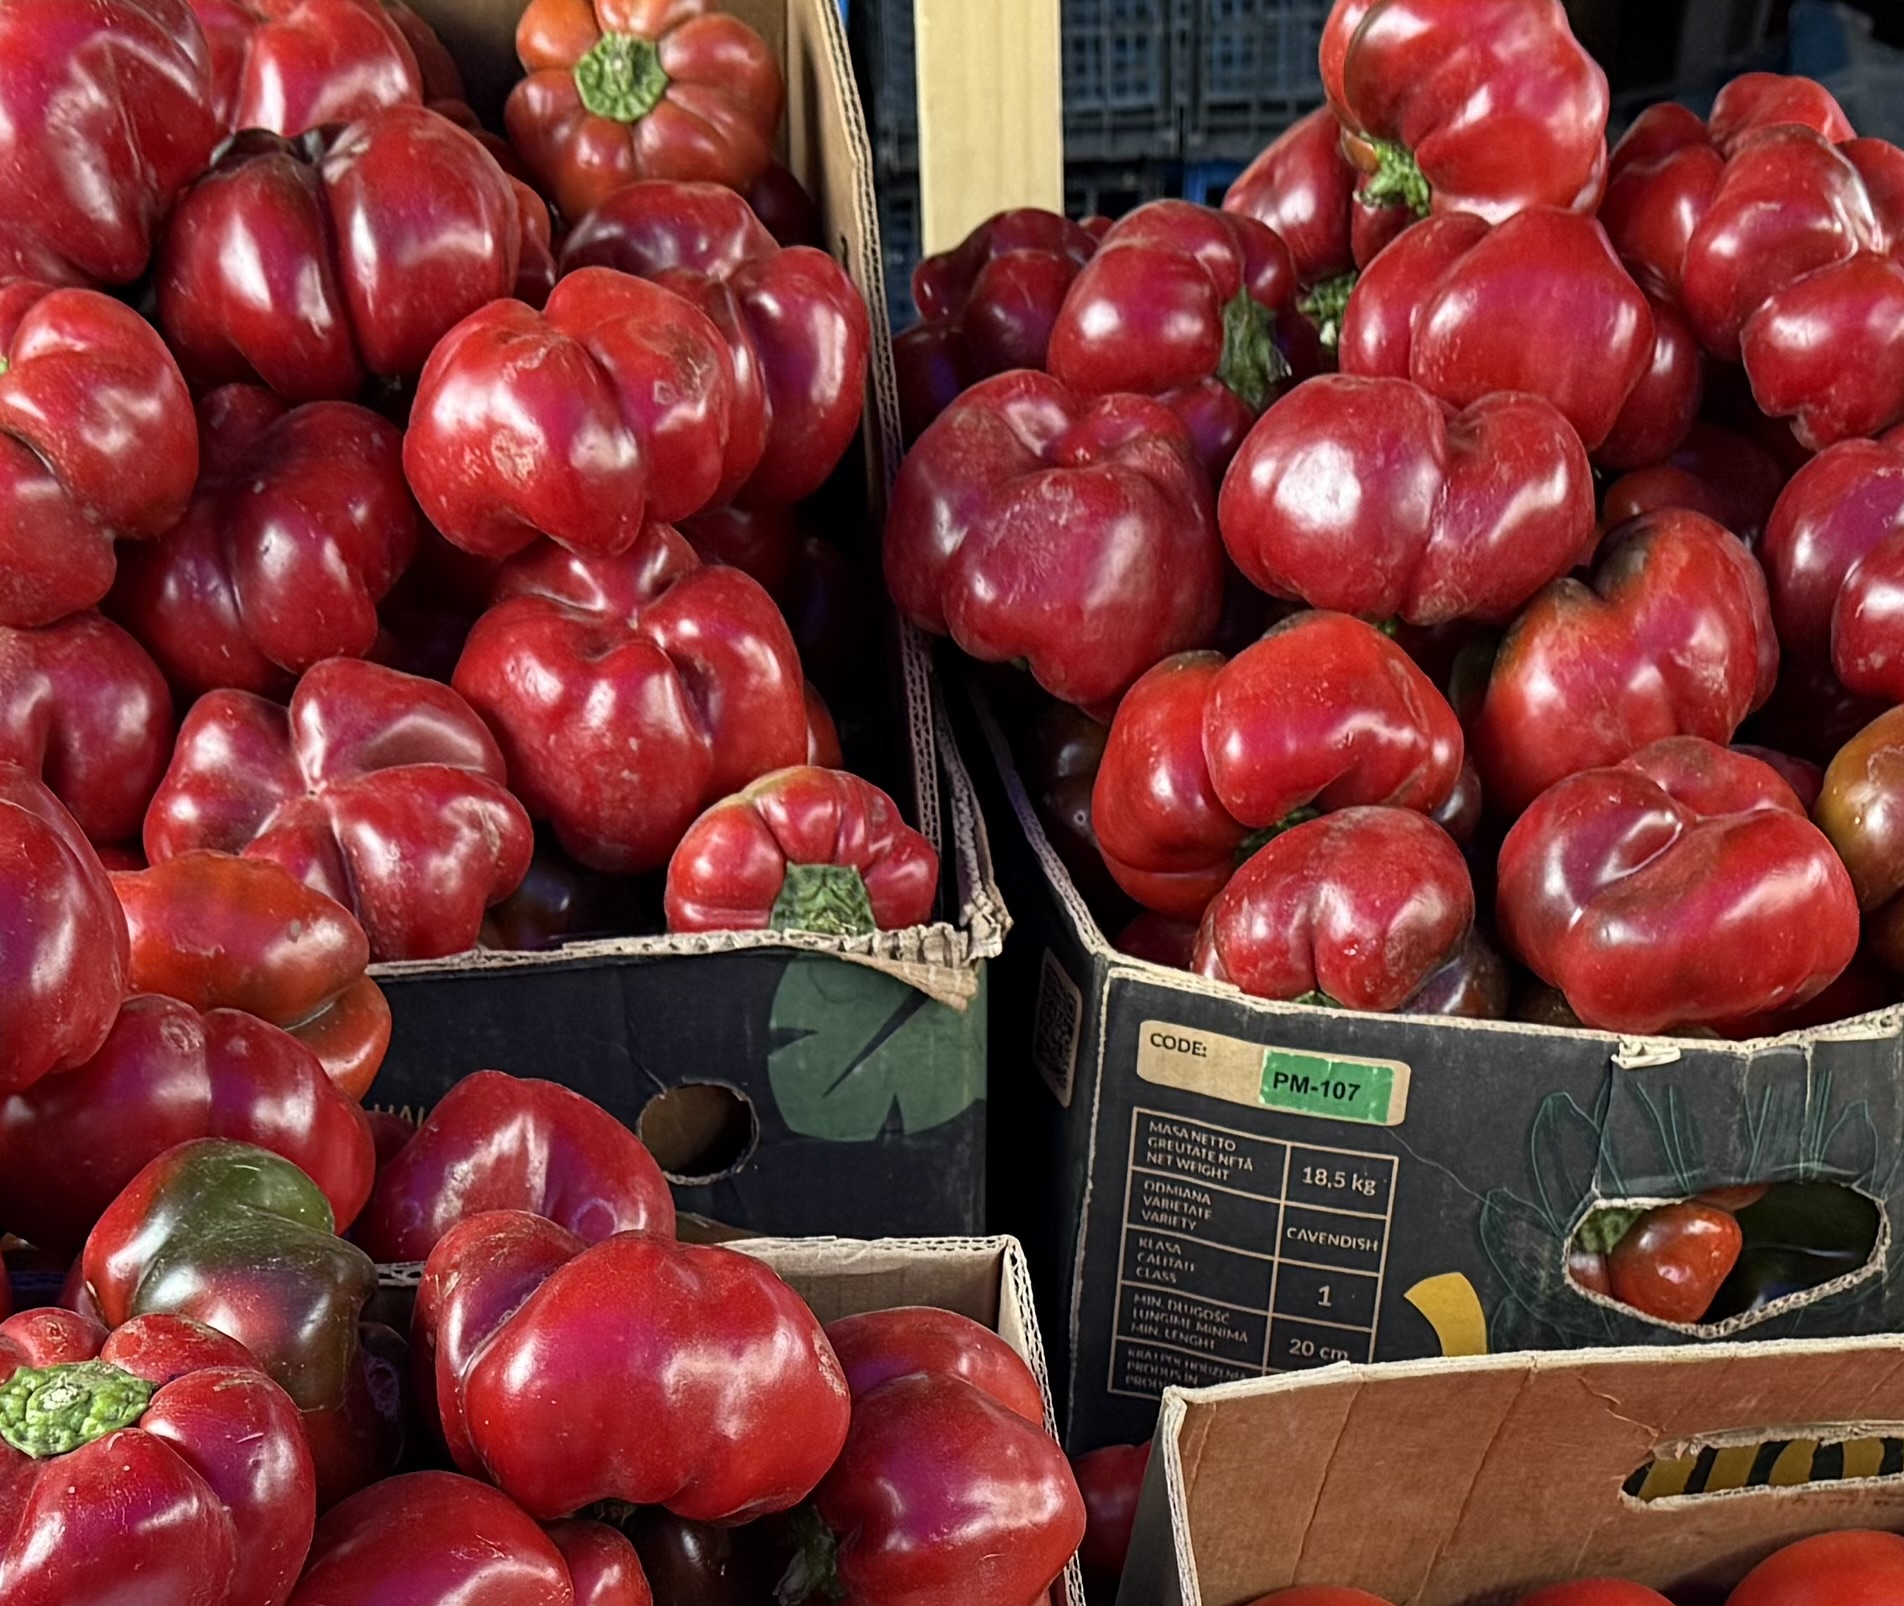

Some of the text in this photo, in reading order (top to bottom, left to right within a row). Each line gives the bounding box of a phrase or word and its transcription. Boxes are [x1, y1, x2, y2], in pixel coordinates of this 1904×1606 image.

[1150, 1031, 1361, 1102] CODE: PM-107
[1149, 1121, 1236, 1151] MASA NETTO
[1351, 1173, 1377, 1197] kg
[1286, 1227, 1378, 1252] CAVENDISH
[1317, 1285, 1332, 1308] 1
[1289, 1338, 1348, 1361] 20 cm
